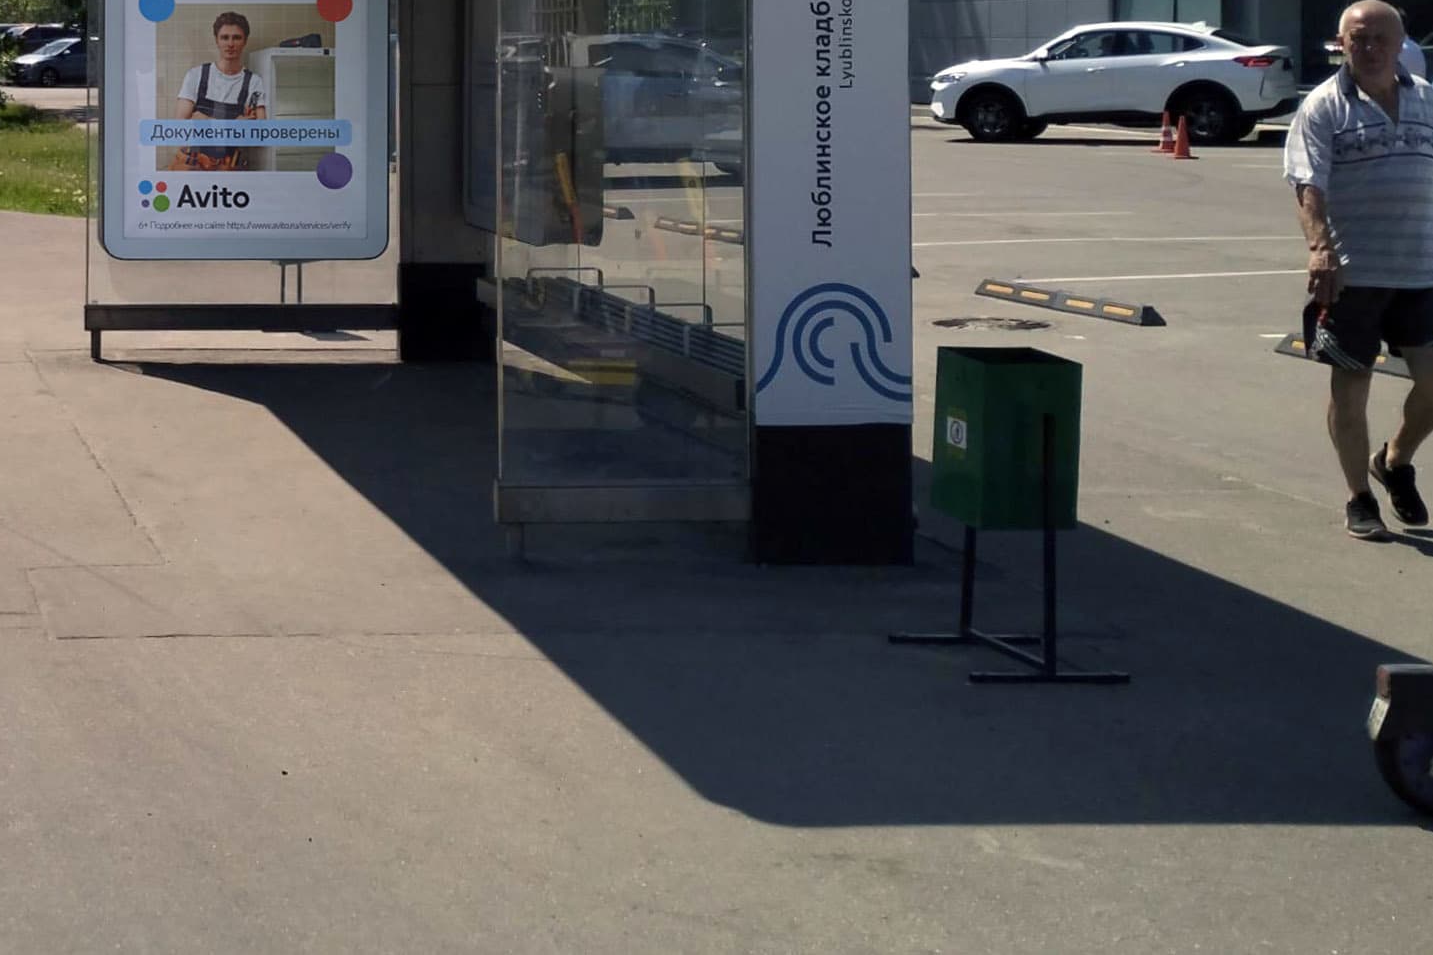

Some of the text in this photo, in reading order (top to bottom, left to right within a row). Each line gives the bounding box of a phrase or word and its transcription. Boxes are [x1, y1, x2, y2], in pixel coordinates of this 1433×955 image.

[151, 124, 340, 143] Документы проверены
[811, 85, 833, 248] Люблинское
[177, 184, 250, 208] Avito
